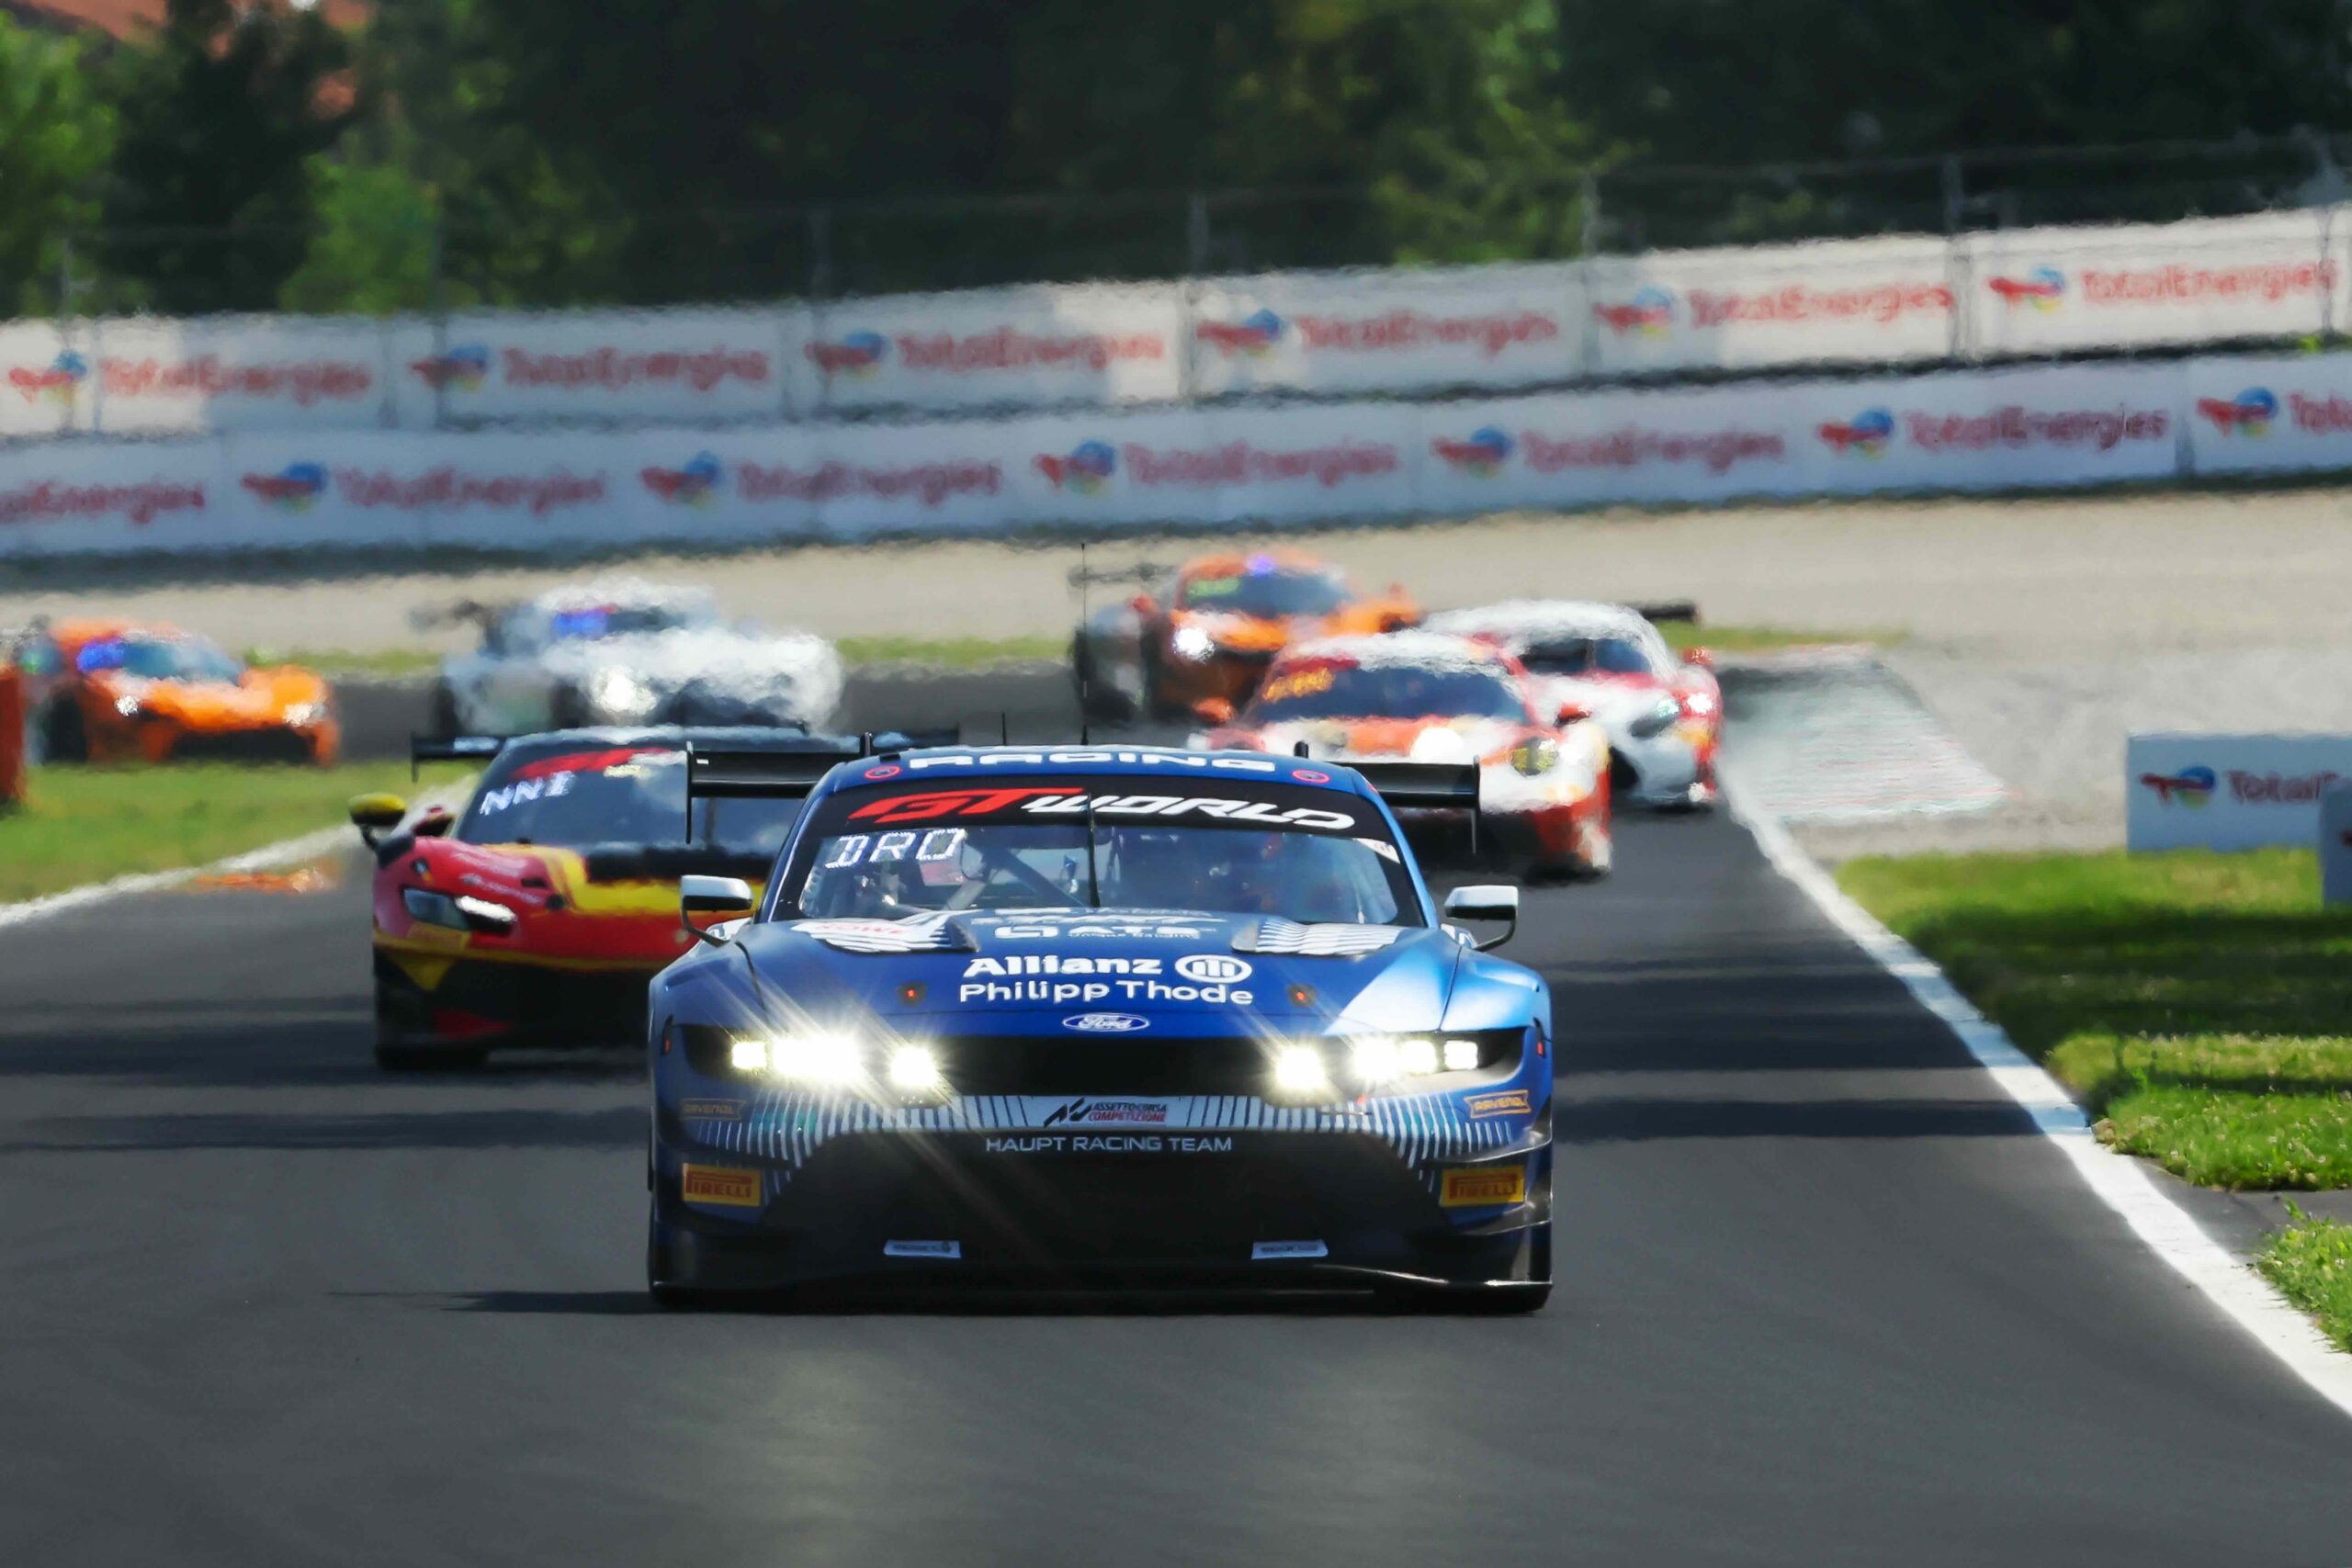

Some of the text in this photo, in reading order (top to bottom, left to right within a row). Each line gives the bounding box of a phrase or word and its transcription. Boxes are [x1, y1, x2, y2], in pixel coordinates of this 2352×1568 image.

[847, 787, 1355, 829] GT WORLD
[963, 954, 1163, 977] Allianz
[959, 980, 1254, 1005] Philipp Thode
[986, 1136, 1232, 1152] HAUPT RACING TEAM
[685, 1171, 753, 1199] PIRELLI
[1449, 1173, 1519, 1200] PIRELLI
